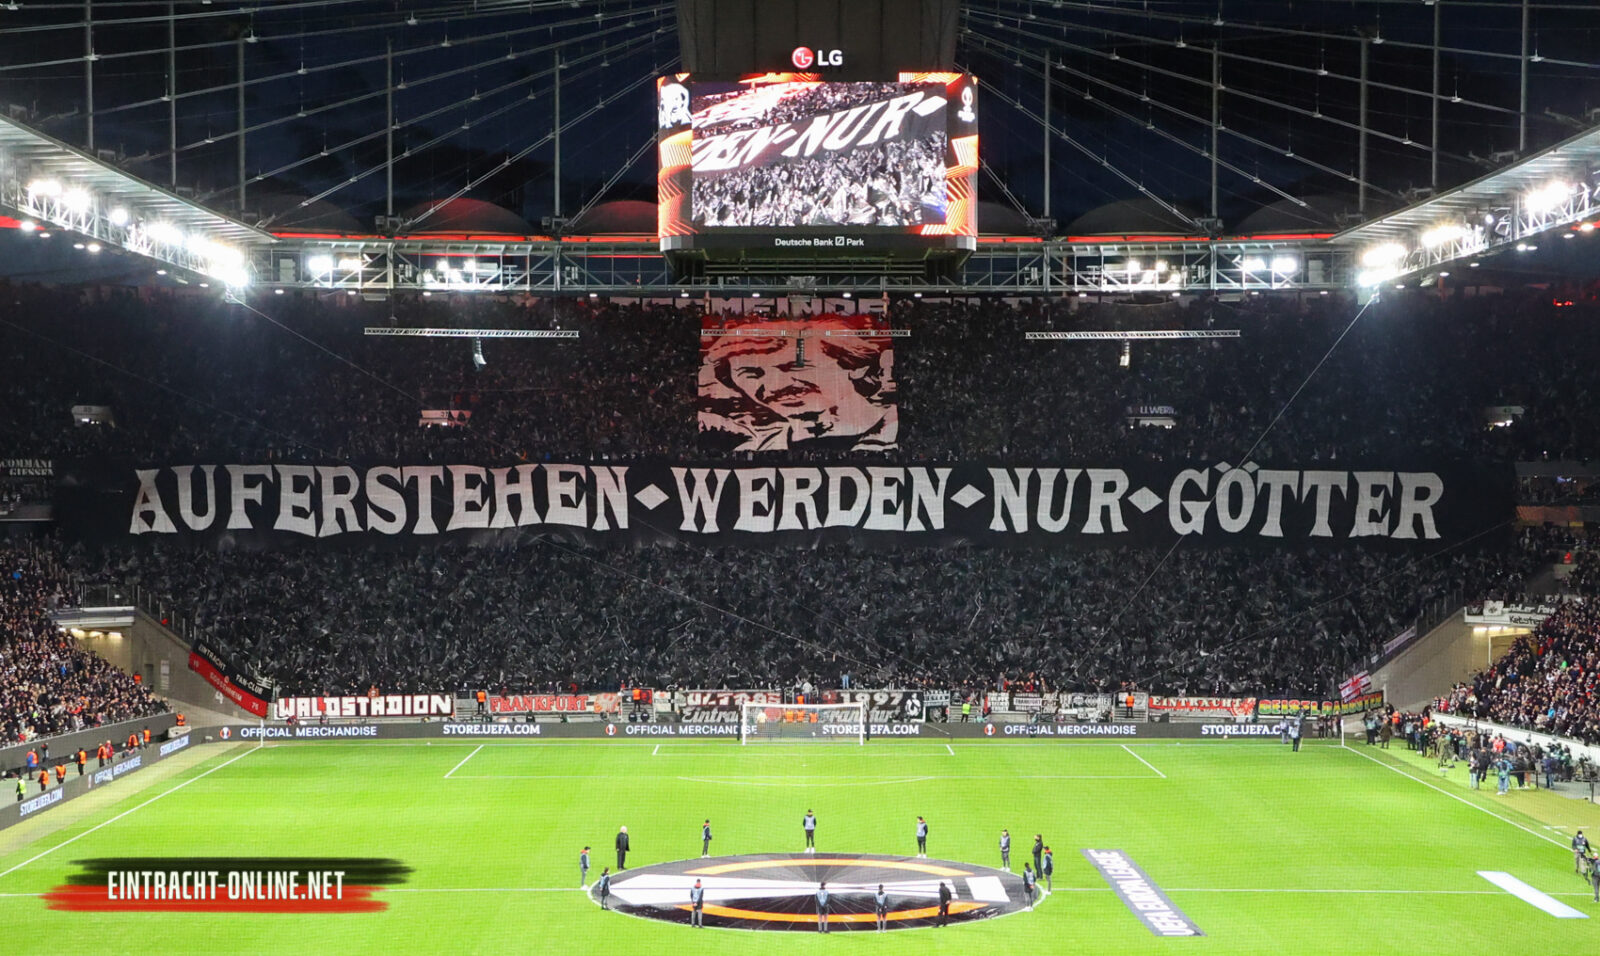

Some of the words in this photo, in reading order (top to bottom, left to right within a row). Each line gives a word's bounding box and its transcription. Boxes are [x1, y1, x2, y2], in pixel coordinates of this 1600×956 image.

[818, 49, 843, 66] LG
[781, 91, 925, 157] NUR
[775, 238, 812, 246] Deutsche
[813, 238, 833, 246] Bank
[846, 238, 865, 246] Park
[130, 463, 629, 538] AUFERSTEHEN
[671, 466, 953, 534] WERDEN
[986, 466, 1130, 534] NUR
[1168, 460, 1444, 539] GÖTTER
[198, 643, 227, 671] EINTRACHT
[235, 674, 264, 695] FAN-CLUB
[215, 691, 225, 704] 4
[489, 695, 589, 713] FRANKFURT
[687, 692, 781, 706] ULTRAS
[840, 691, 904, 706] 1997
[1152, 695, 1242, 708] EINTRACHT
[278, 694, 453, 717] WALDSTADION
[240, 728, 292, 738] OFFICIAL
[295, 726, 378, 737] MERCHANDISE
[443, 724, 541, 734] STORE.UEFA.COM
[625, 725, 676, 735] OFFICIAL
[678, 725, 758, 735] MERCHANDSE
[822, 724, 920, 734] STOREEFA.COM
[1057, 725, 1137, 735] MERCHANDISE
[1201, 724, 1297, 735] STORE.UEFA.C
